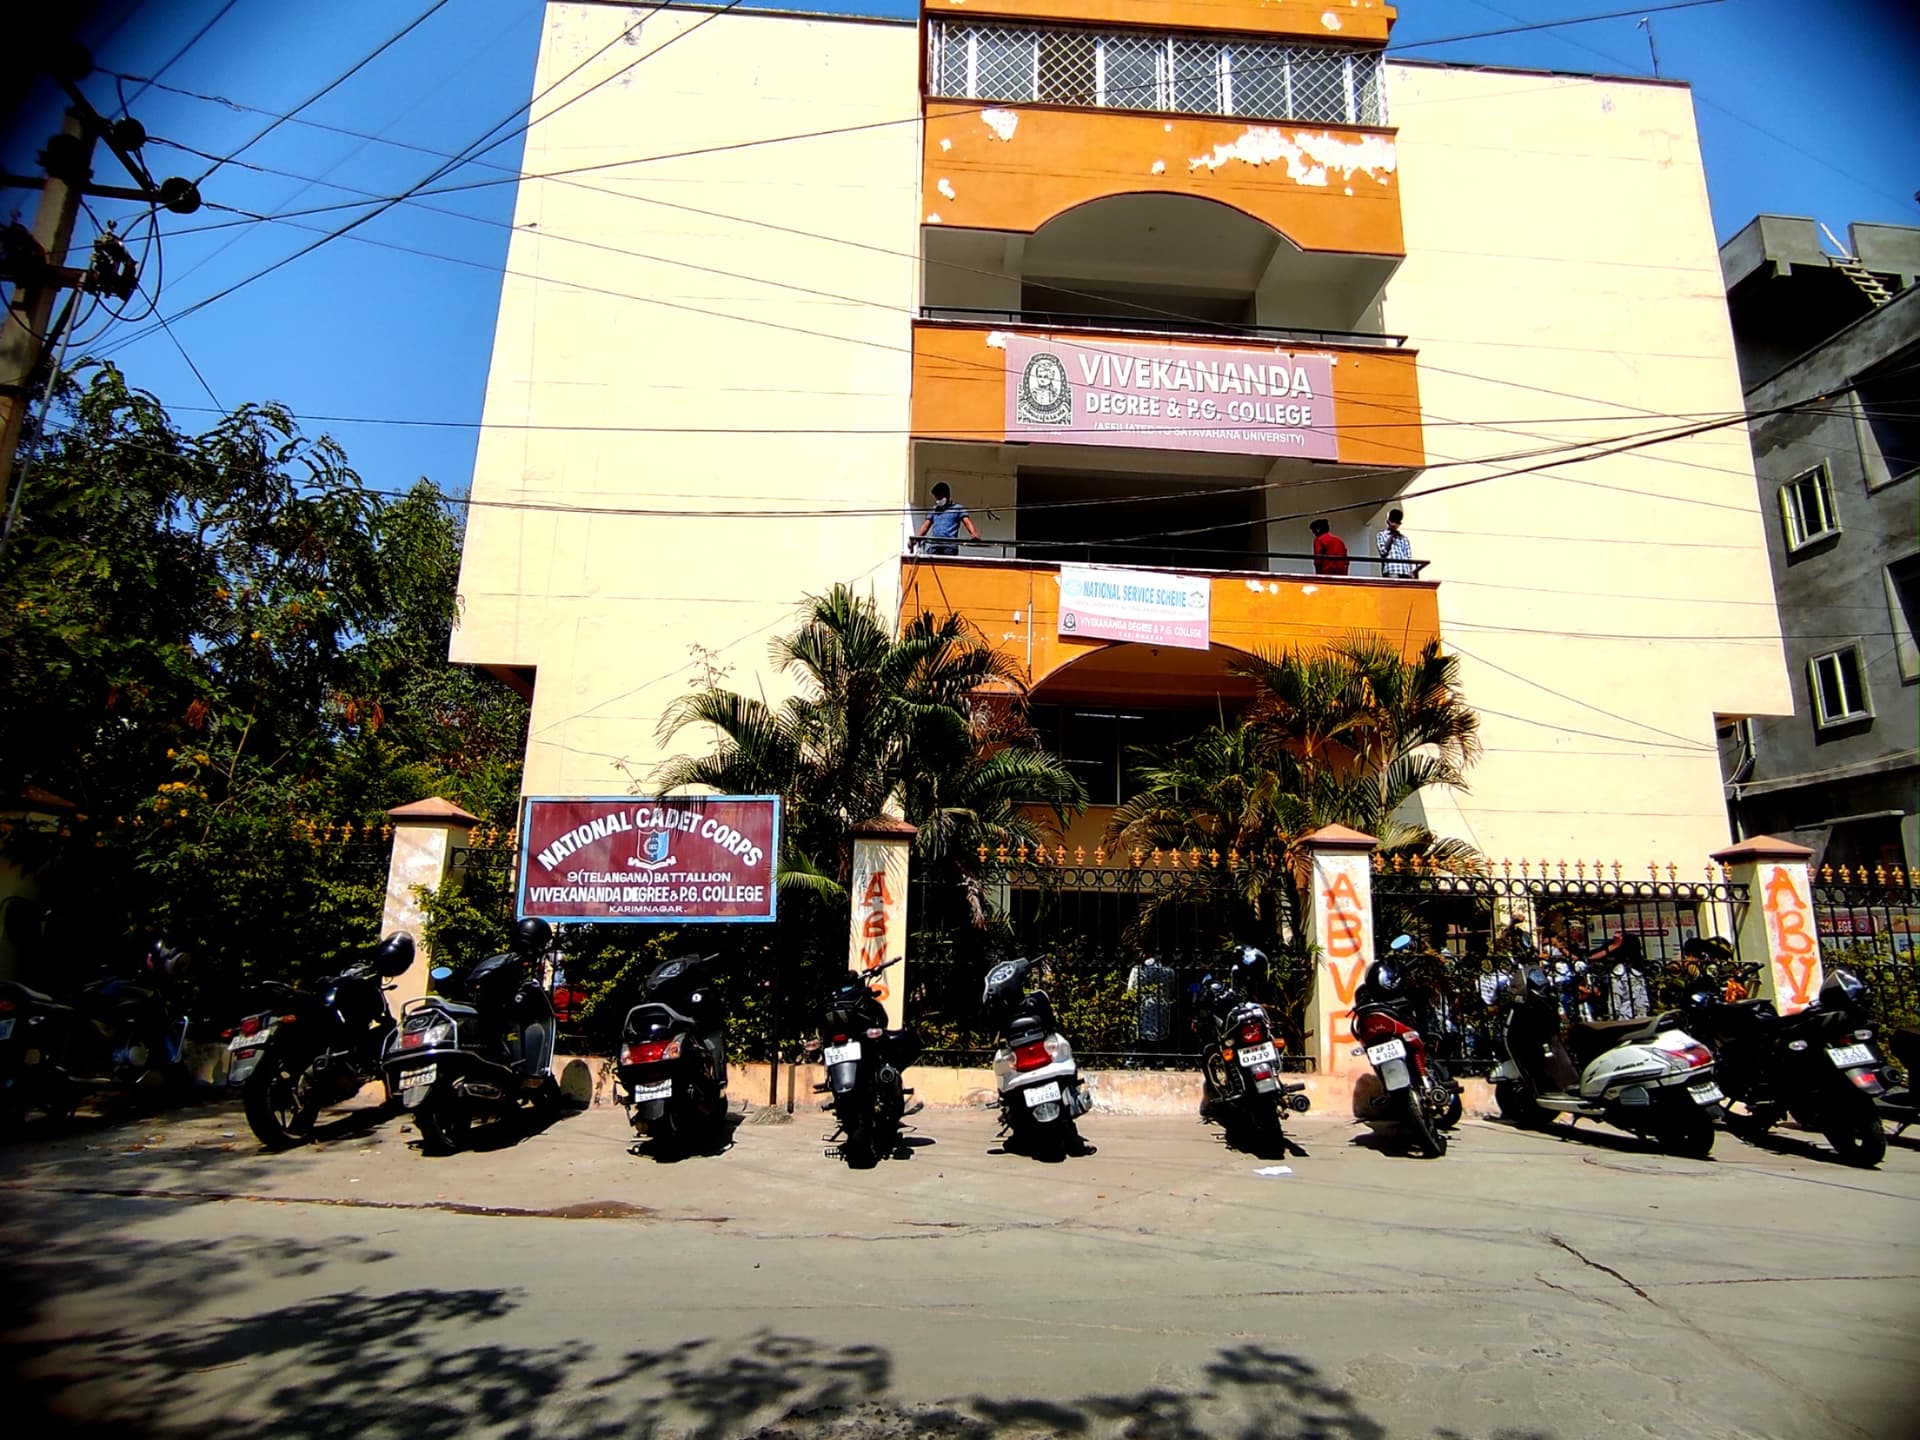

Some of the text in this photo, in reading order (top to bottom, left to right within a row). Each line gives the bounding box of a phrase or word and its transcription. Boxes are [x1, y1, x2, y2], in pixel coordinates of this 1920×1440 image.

[1079, 353, 1313, 399] VIVEKANANDA
[1086, 392, 1160, 418] DEGREE
[1166, 398, 1181, 418] &
[1188, 399, 1221, 421] P.G.
[1227, 401, 1312, 426] COLLEGE
[1174, 428, 1241, 441] SATAVAHANA
[1243, 430, 1305, 446] UNIVERSITY)
[1083, 581, 1187, 608] NATIONAL SERVICE SCHEME
[1128, 621, 1152, 633] DEGREE
[1174, 626, 1201, 638] COLLEGE
[537, 807, 763, 872] NATIONAL CADET CORPS
[530, 886, 621, 902] VIVEKANANDA
[623, 886, 670, 902] DEGREE
[680, 886, 701, 902] P.G.
[702, 886, 764, 902] COLLEGE
